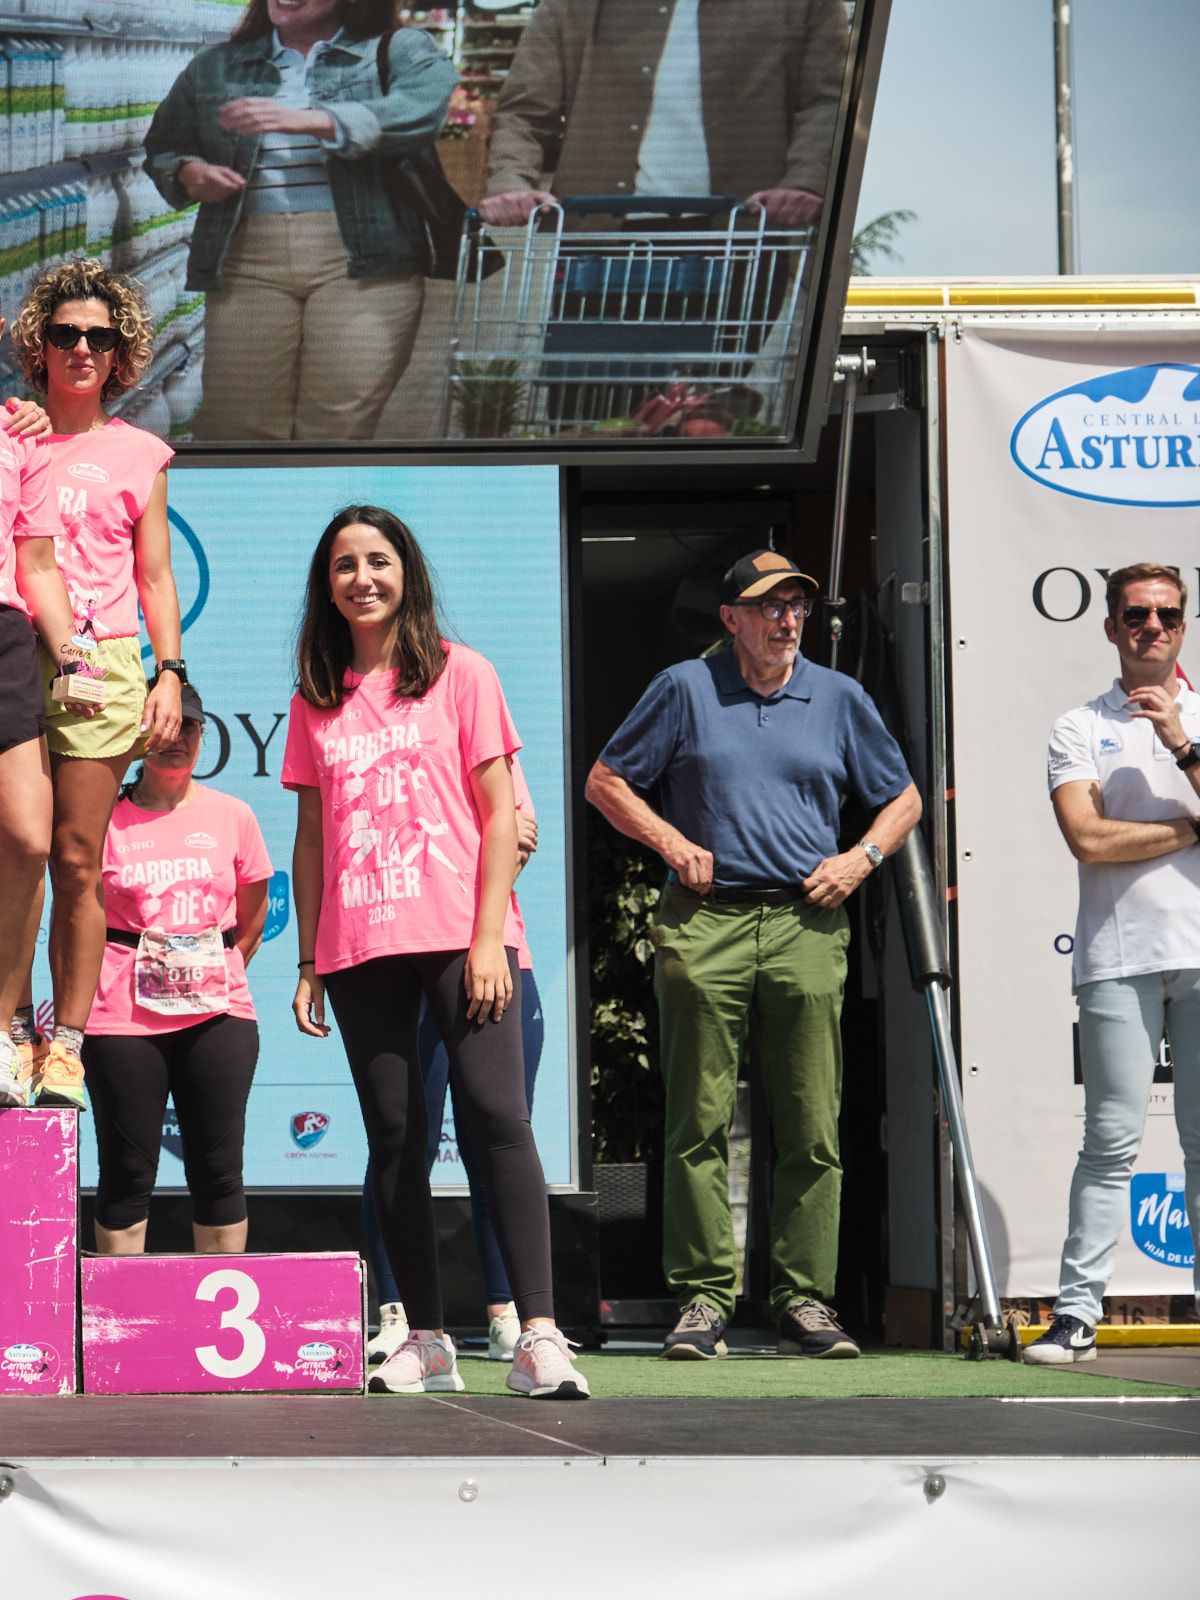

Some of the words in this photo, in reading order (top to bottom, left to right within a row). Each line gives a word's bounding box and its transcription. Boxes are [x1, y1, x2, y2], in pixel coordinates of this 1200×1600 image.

[1084, 413, 1182, 426] CENTRAL
[1035, 417, 1200, 469] ASTUR
[60, 644, 91, 660] Carrera
[191, 711, 287, 780] OY
[323, 721, 422, 768] CARRERA
[377, 760, 409, 807] DE
[375, 829, 401, 868] LA
[121, 857, 215, 888] CARRERA
[342, 866, 421, 910] MUJER
[172, 887, 200, 926] DE
[368, 904, 396, 926] 2026
[168, 967, 204, 983] 016
[1144, 1240, 1165, 1260] HIJA
[1167, 1252, 1181, 1264] DE
[1183, 1255, 1195, 1265] LO
[195, 1269, 267, 1379] 3
[1, 1360, 34, 1371] Carrera
[18, 1368, 43, 1385] Mujer
[295, 1358, 327, 1370] Carrera
